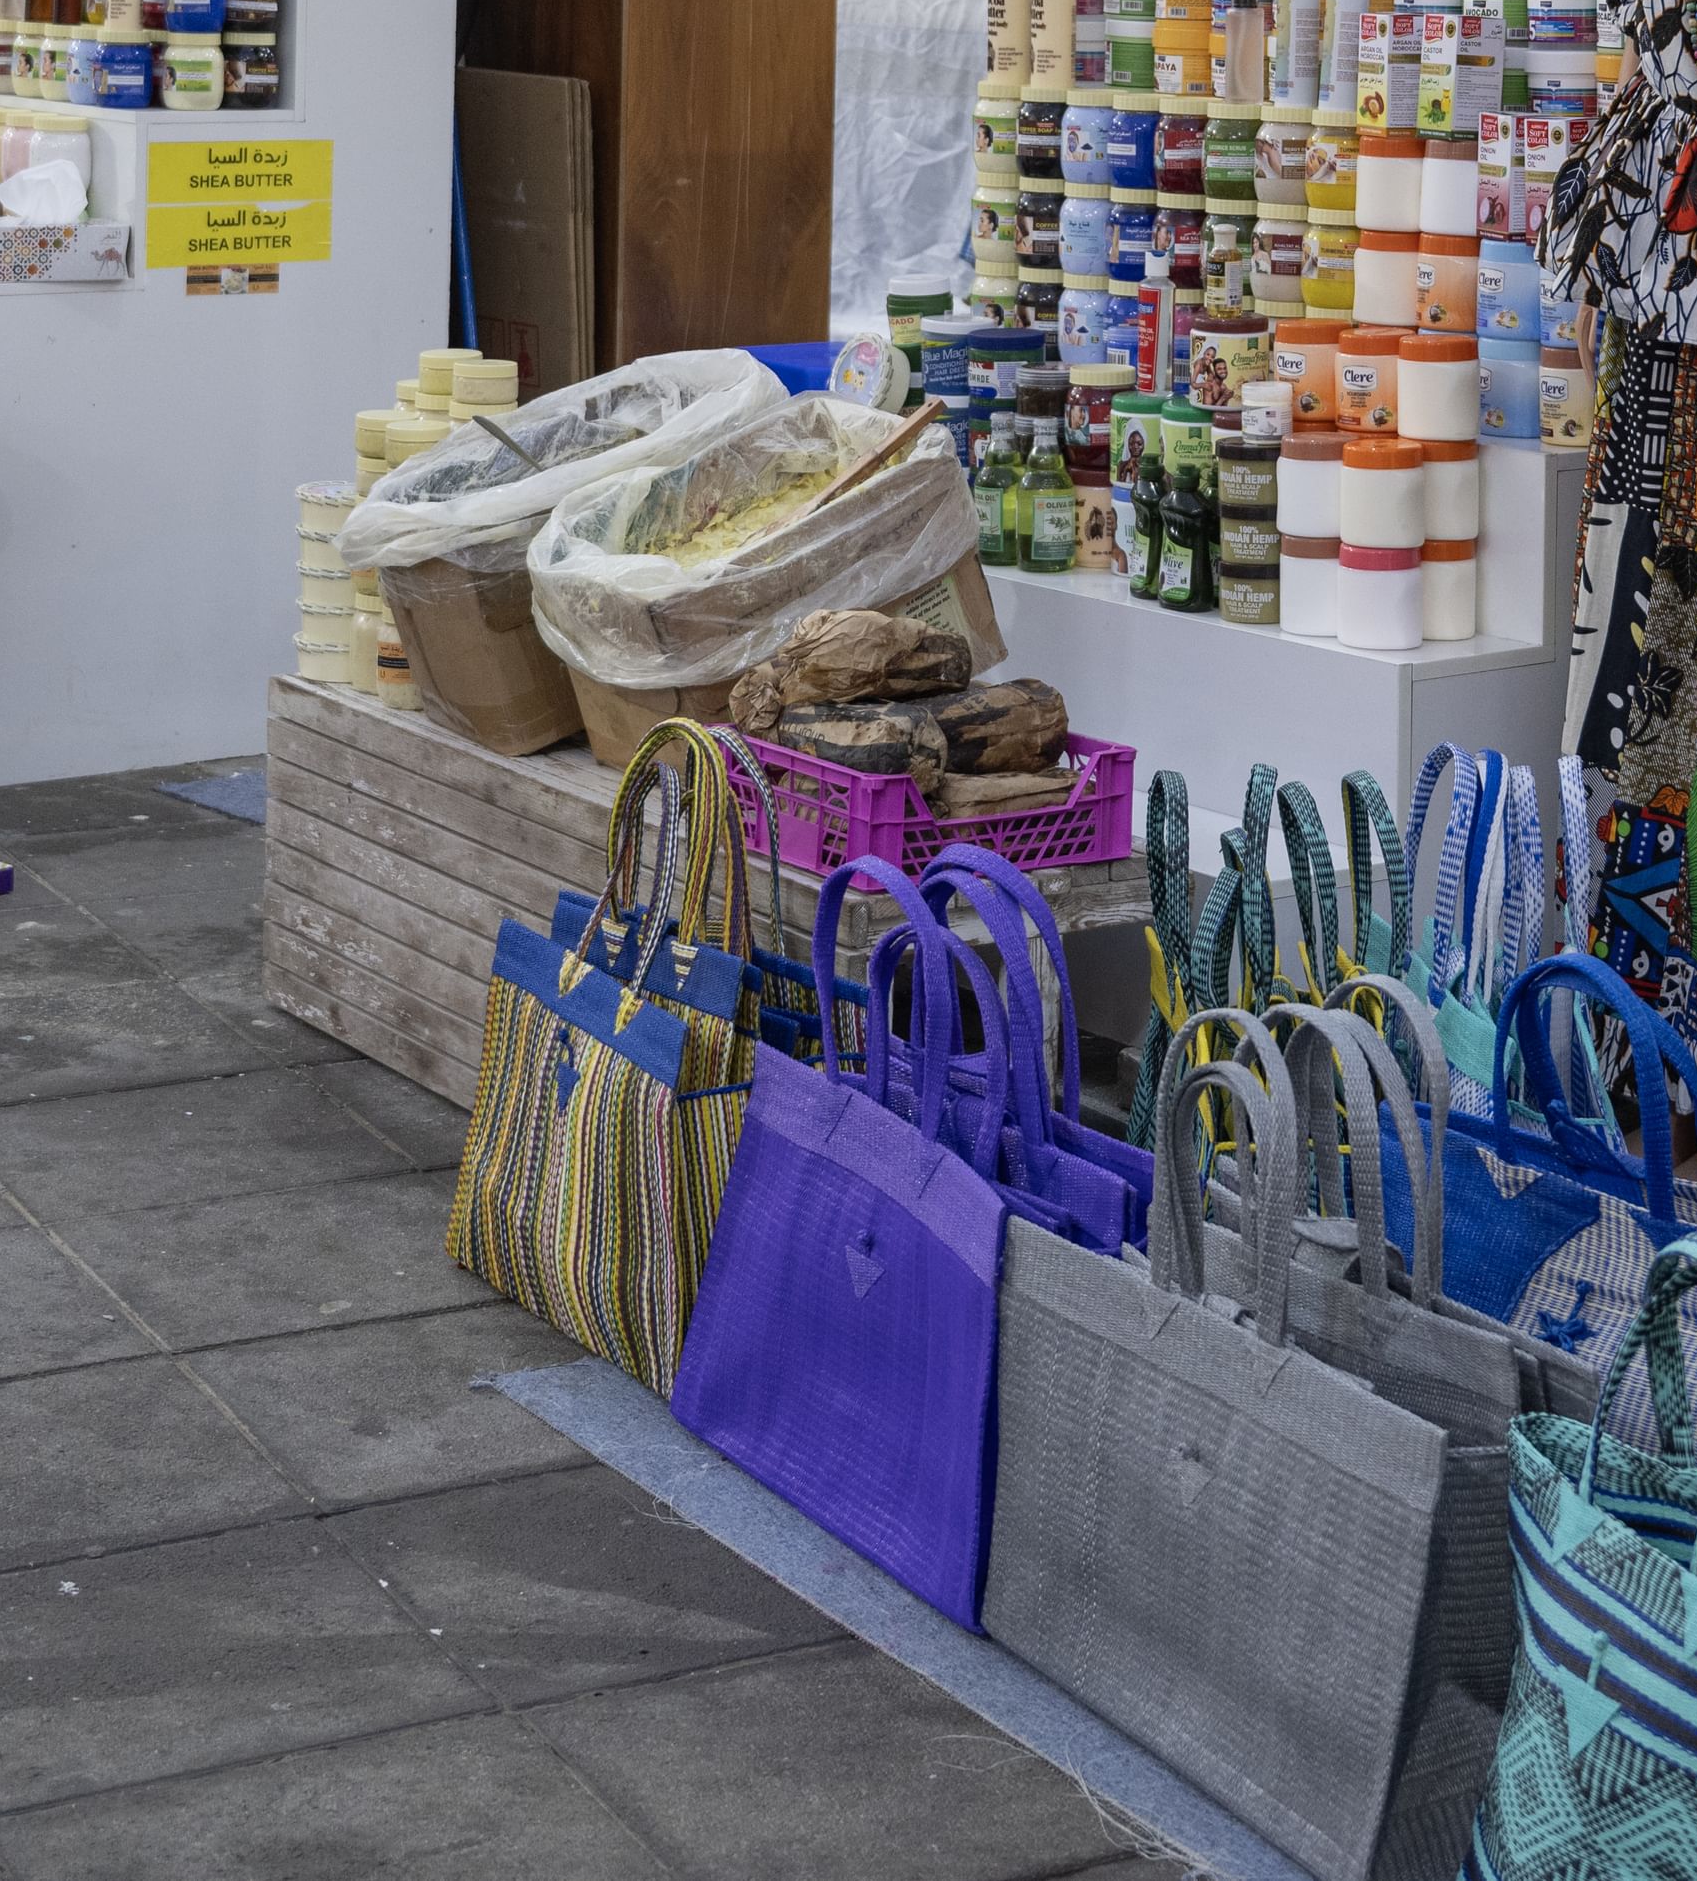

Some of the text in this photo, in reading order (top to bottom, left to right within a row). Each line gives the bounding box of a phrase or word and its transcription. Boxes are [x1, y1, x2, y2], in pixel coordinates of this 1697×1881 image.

[1528, 20, 1536, 40] 5
[1423, 46, 1443, 54] CASTOR
[208, 147, 288, 169] زبدة السيا
[1527, 153, 1546, 161] ONION
[189, 173, 293, 189] SHEA BUTTER
[206, 210, 287, 232] زبدة السيا
[188, 235, 292, 252] SHEA BUTTER
[1478, 272, 1502, 286] Clere
[924, 346, 968, 361] Blue Magi
[1277, 355, 1303, 369] Clere
[1344, 369, 1374, 383] Clere
[1541, 380, 1565, 395] Clere
[1232, 465, 1251, 474] 100%
[1245, 474, 1273, 484] HEMP
[985, 494, 995, 502] OIL
[1046, 501, 1068, 509] OLIVA
[1238, 525, 1259, 534] 100%
[1253, 534, 1280, 544] HEMP
[1233, 583, 1252, 592] 100%
[1246, 592, 1275, 602] HEMP
